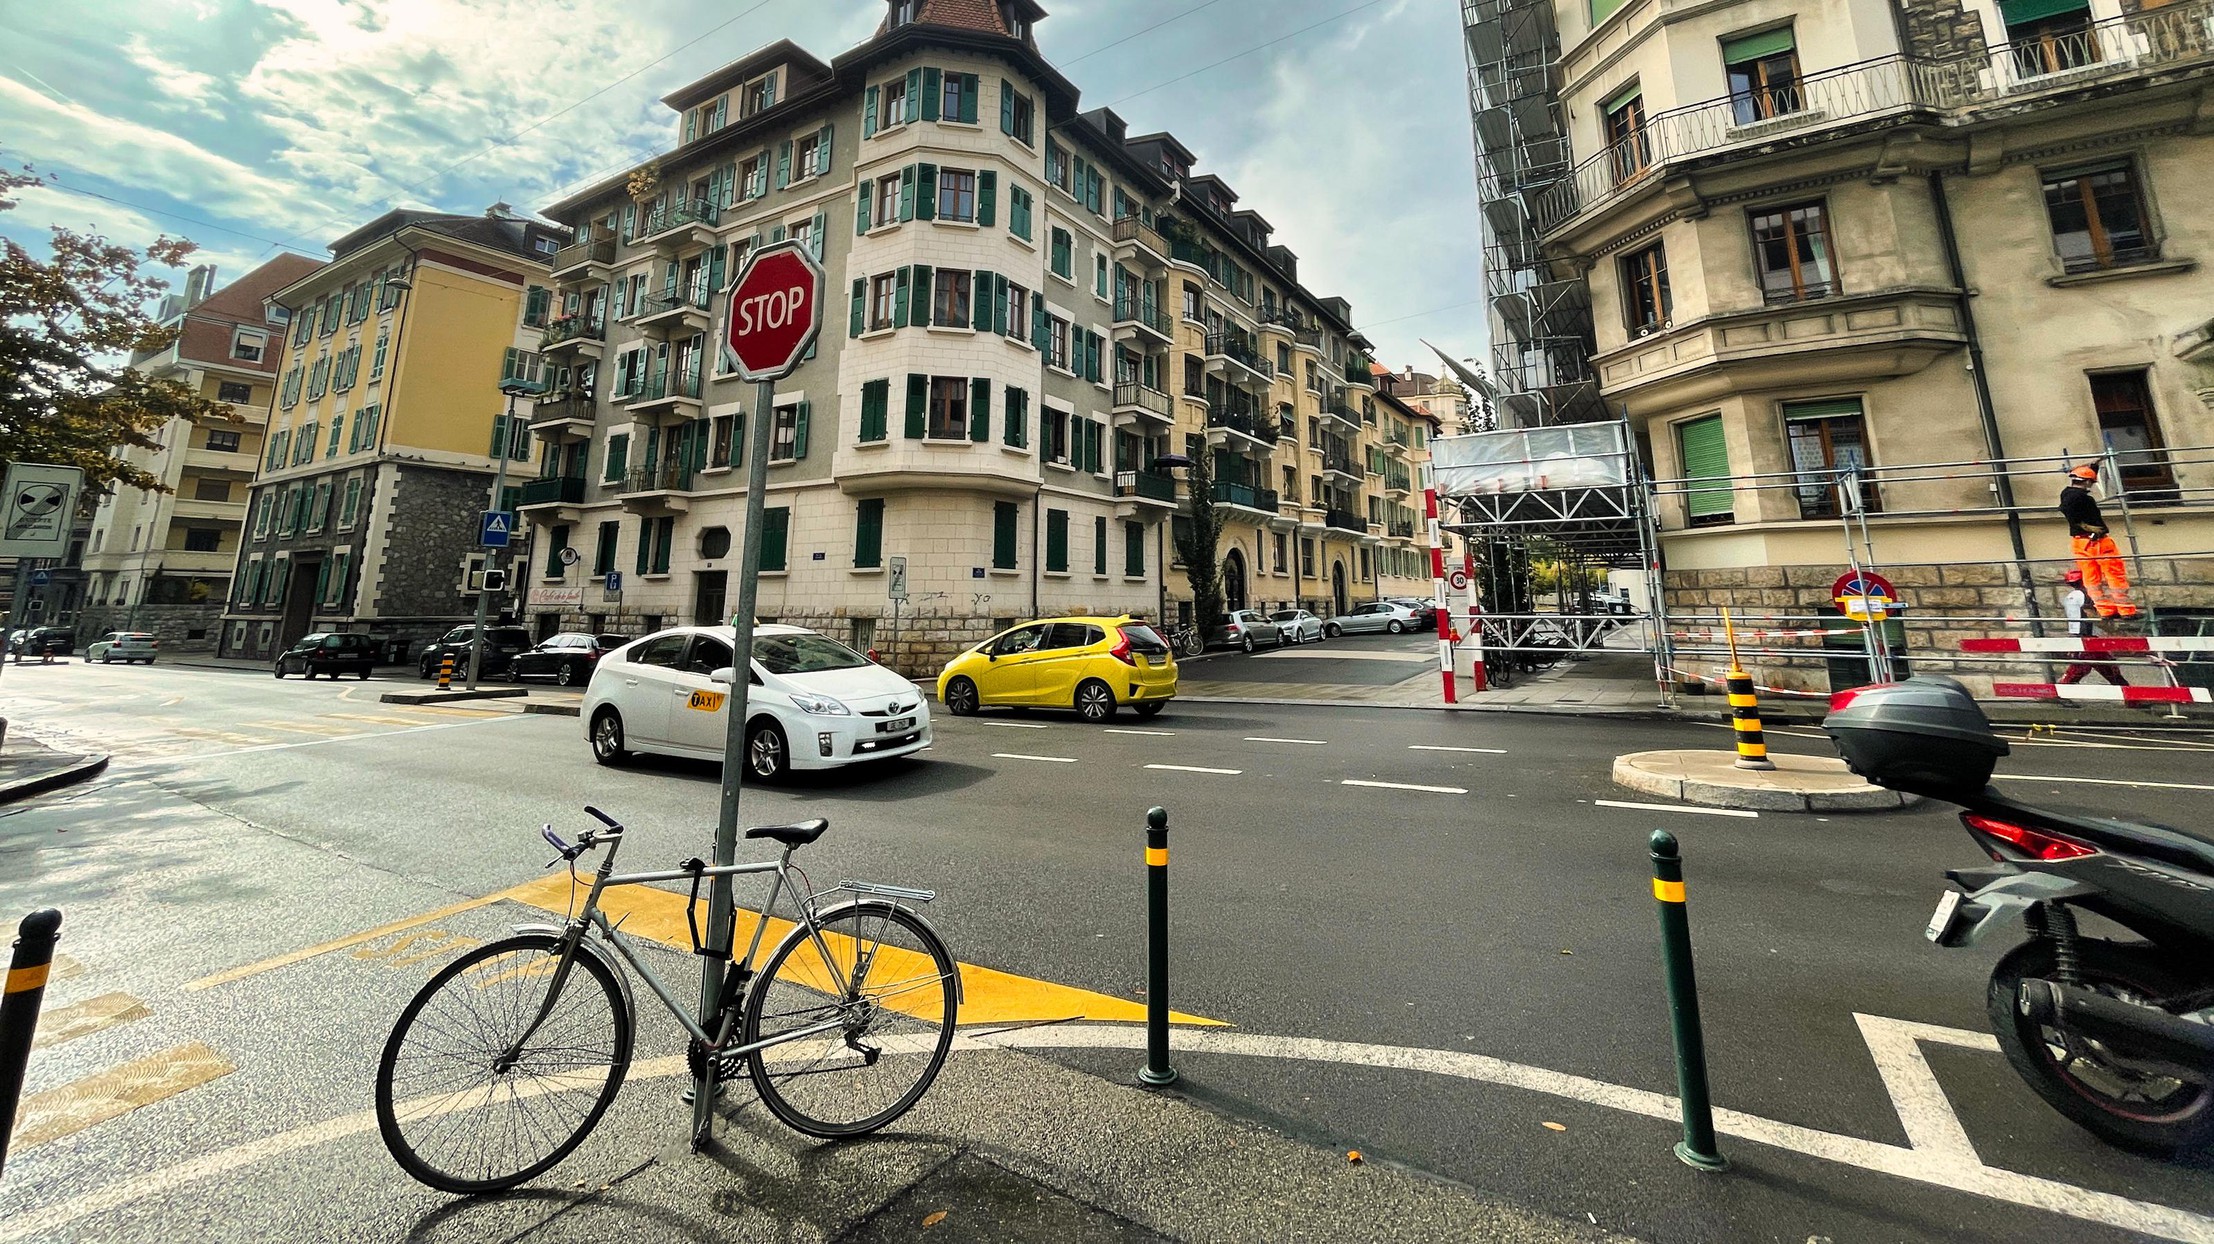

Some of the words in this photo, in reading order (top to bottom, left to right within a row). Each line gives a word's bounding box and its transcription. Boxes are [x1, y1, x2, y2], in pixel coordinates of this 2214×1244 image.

[738, 286, 805, 336] STOP
[1456, 576, 1464, 585] 30
[691, 692, 716, 708] TAXI
